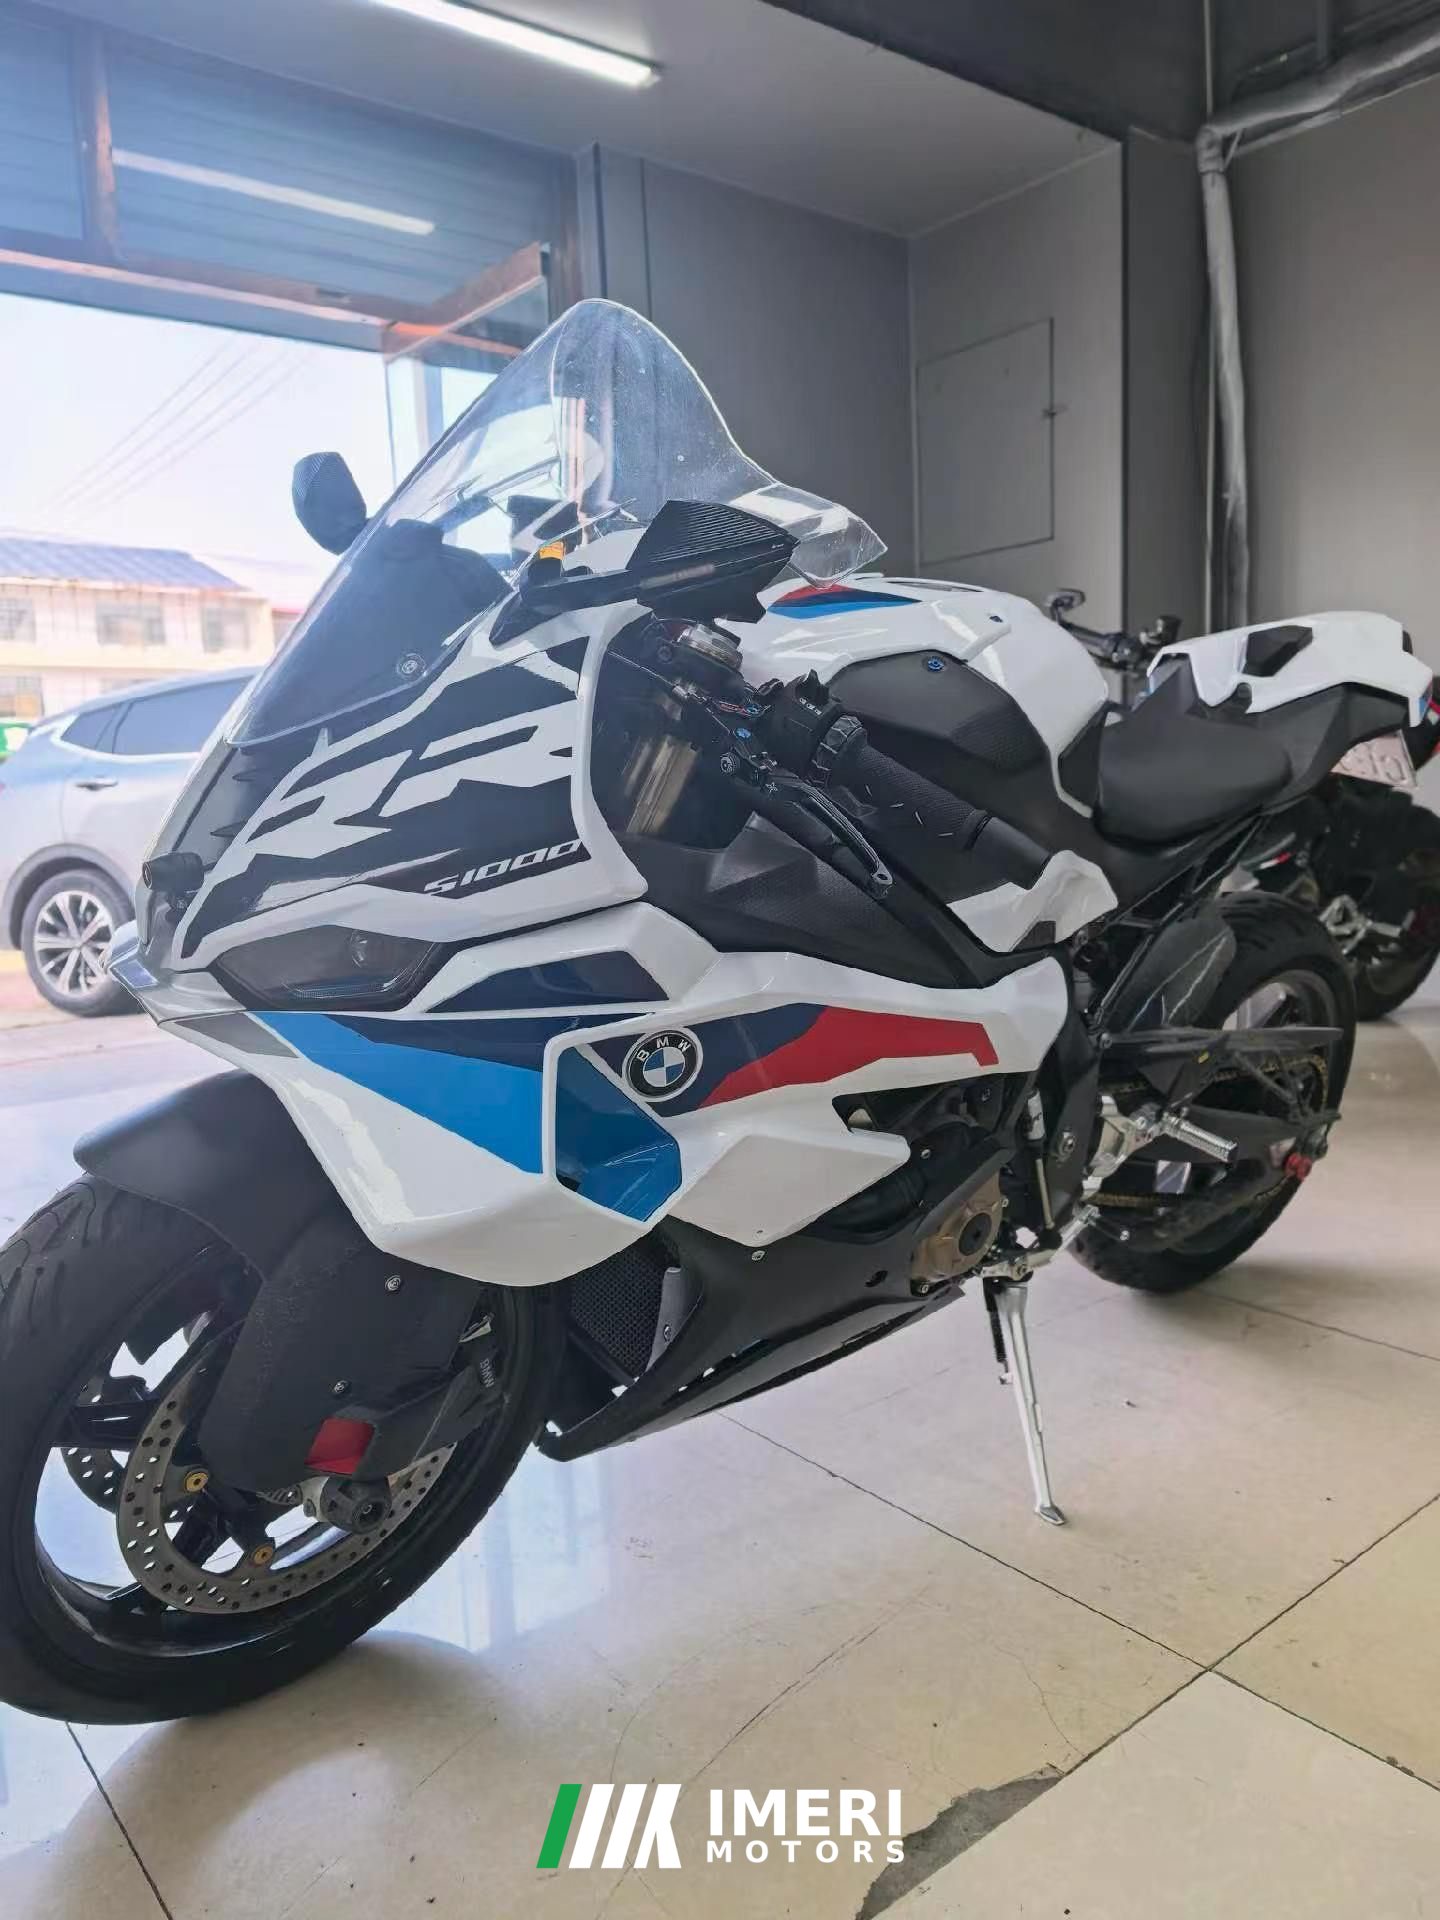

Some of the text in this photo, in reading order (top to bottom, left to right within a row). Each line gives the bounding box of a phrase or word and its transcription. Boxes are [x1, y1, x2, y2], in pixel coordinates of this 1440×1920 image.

[424, 839, 582, 894] S1000
[637, 1036, 691, 1062] BMW
[480, 1358, 495, 1388] BMW
